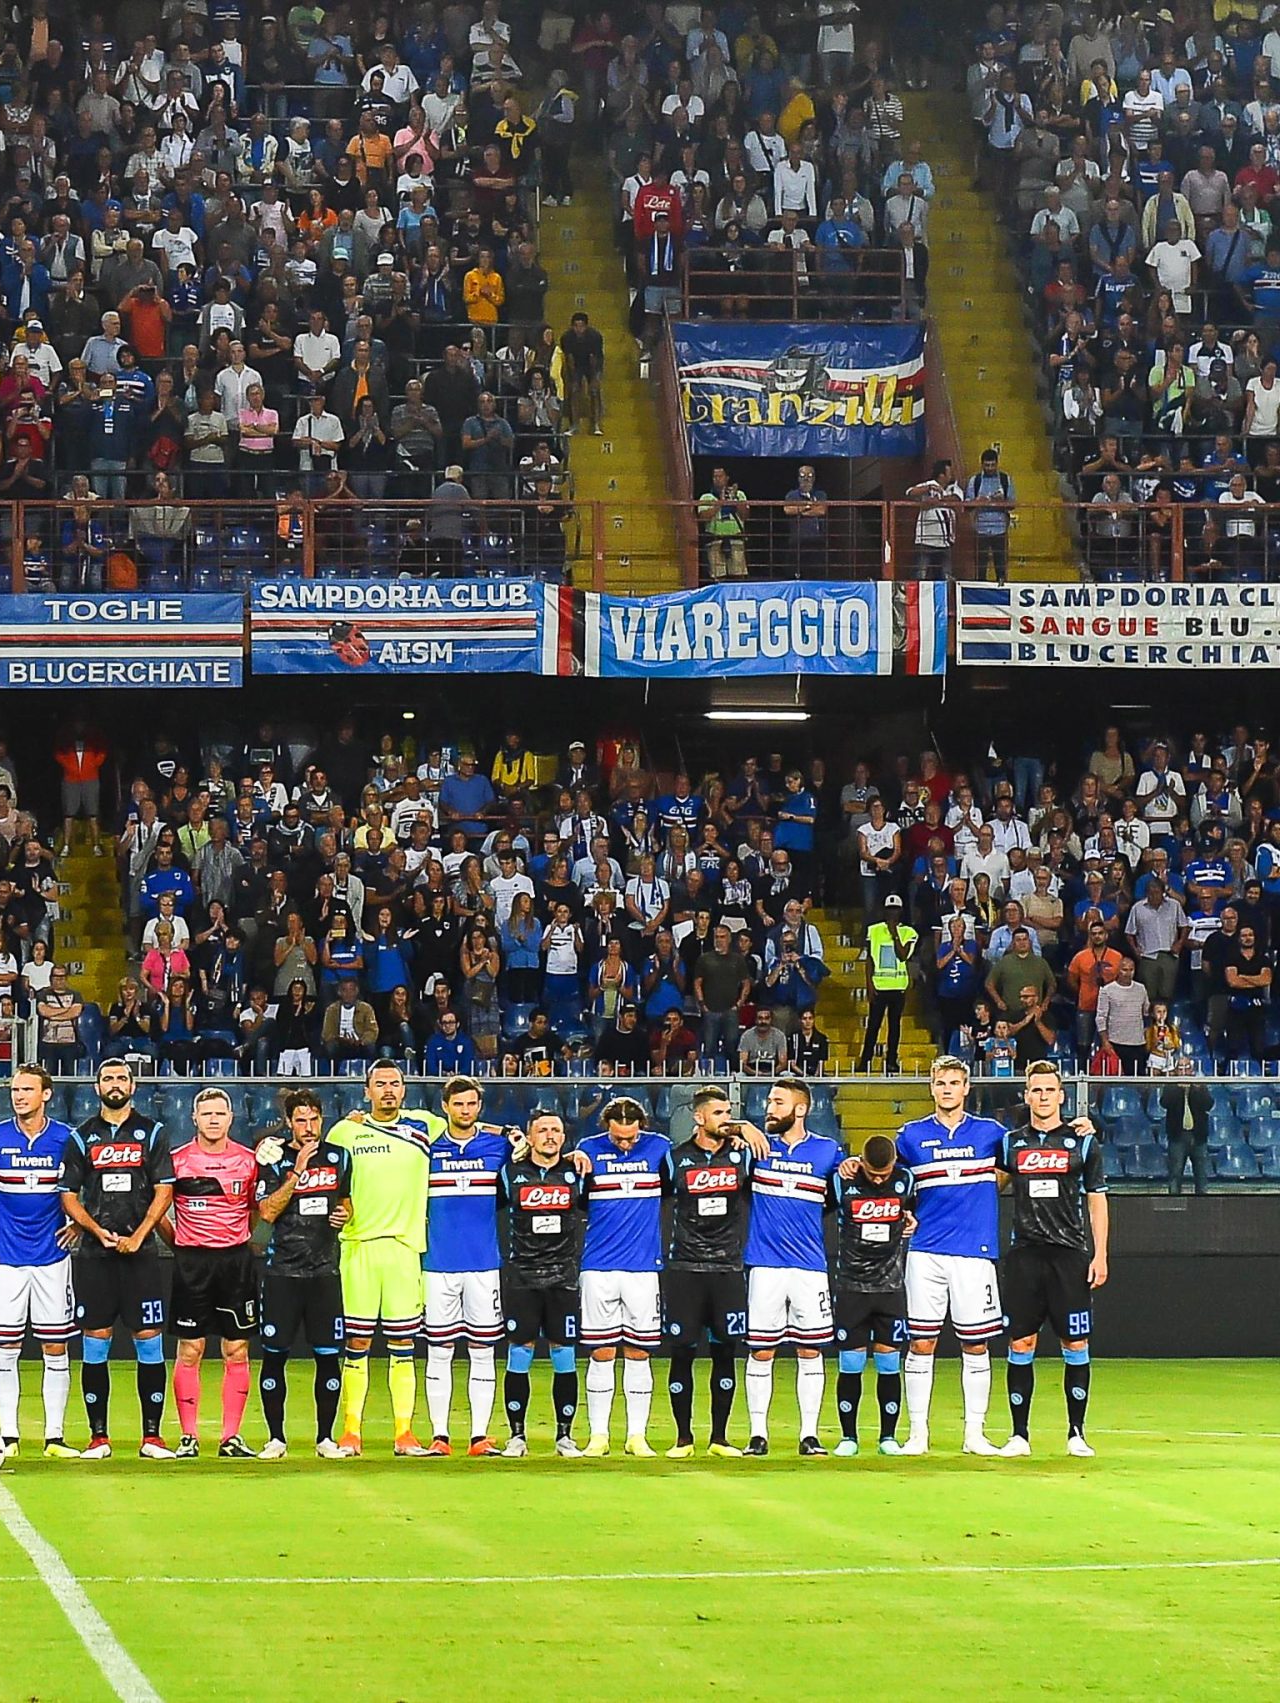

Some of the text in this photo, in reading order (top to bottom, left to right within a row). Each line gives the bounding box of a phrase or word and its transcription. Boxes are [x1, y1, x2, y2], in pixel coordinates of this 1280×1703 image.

[644, 196, 671, 208] Lete
[260, 583, 528, 609] SAMPDORIA CLUB
[1019, 587, 1230, 607] SAMPDORIA
[43, 599, 183, 622] TOGHE
[609, 597, 871, 662] VIAREGGIO
[1019, 615, 1250, 637] SANGUE BLU
[378, 641, 454, 665] AISM
[8, 661, 231, 684] BLUCERCHIATE
[92, 1145, 142, 1165] Lete
[351, 1143, 391, 1156] Invent
[931, 1145, 975, 1160] Invent
[11, 1154, 53, 1167] Invent
[442, 1158, 485, 1171] Invent
[606, 1160, 649, 1173] Invent
[771, 1157, 813, 1174] Invent
[1017, 1152, 1069, 1171] Lete
[687, 1170, 737, 1190] Lete
[520, 1188, 570, 1207] Lete
[852, 1201, 901, 1220] Lete
[985, 1284, 993, 1305] 3
[142, 1300, 163, 1324] 33
[334, 1317, 343, 1340] 9
[565, 1315, 576, 1338] 6
[726, 1311, 746, 1335] 23
[1069, 1311, 1090, 1336] 99
